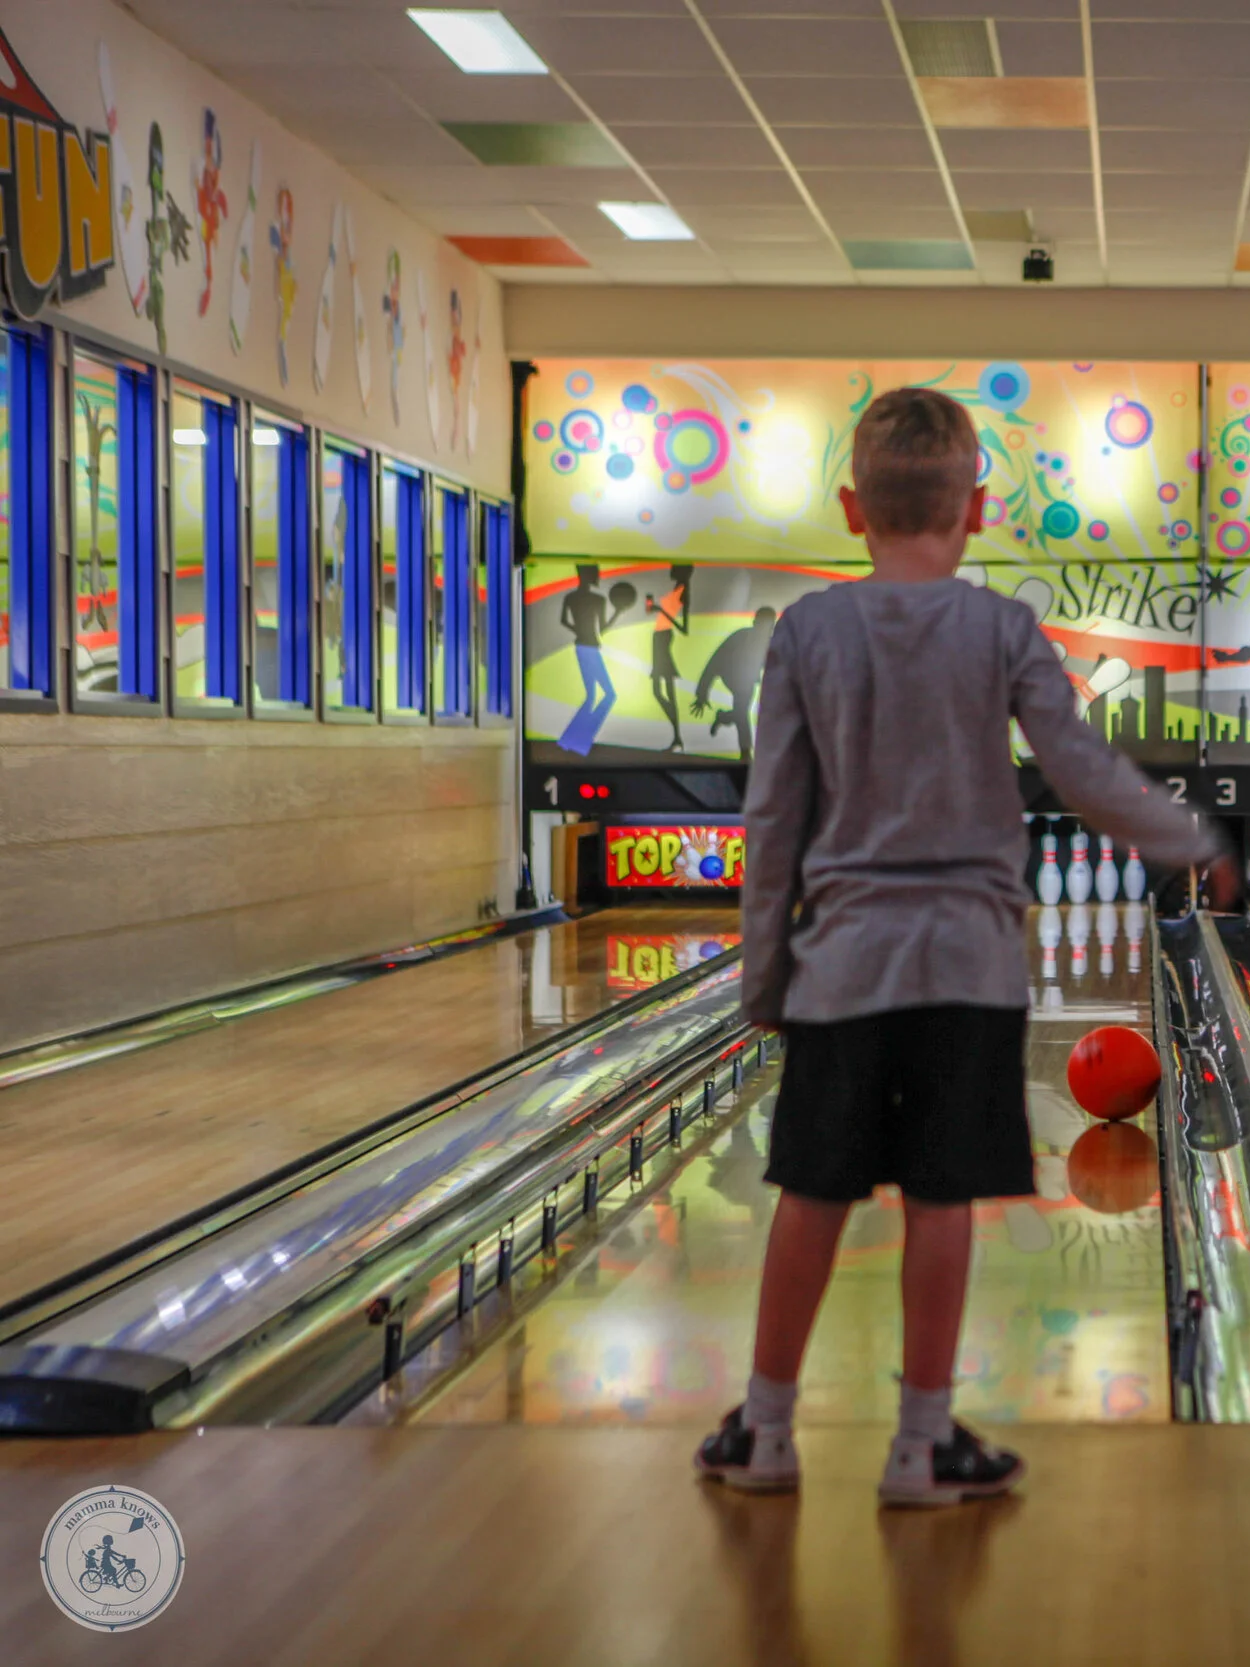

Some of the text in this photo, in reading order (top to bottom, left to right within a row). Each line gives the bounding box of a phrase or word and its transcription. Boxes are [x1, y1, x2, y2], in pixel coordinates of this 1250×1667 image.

[0, 113, 113, 288] UN
[1056, 564, 1199, 638] Strike
[544, 776, 558, 806] 1
[1166, 776, 1187, 805] 2
[1215, 778, 1237, 806] 3
[609, 832, 682, 881] TOP
